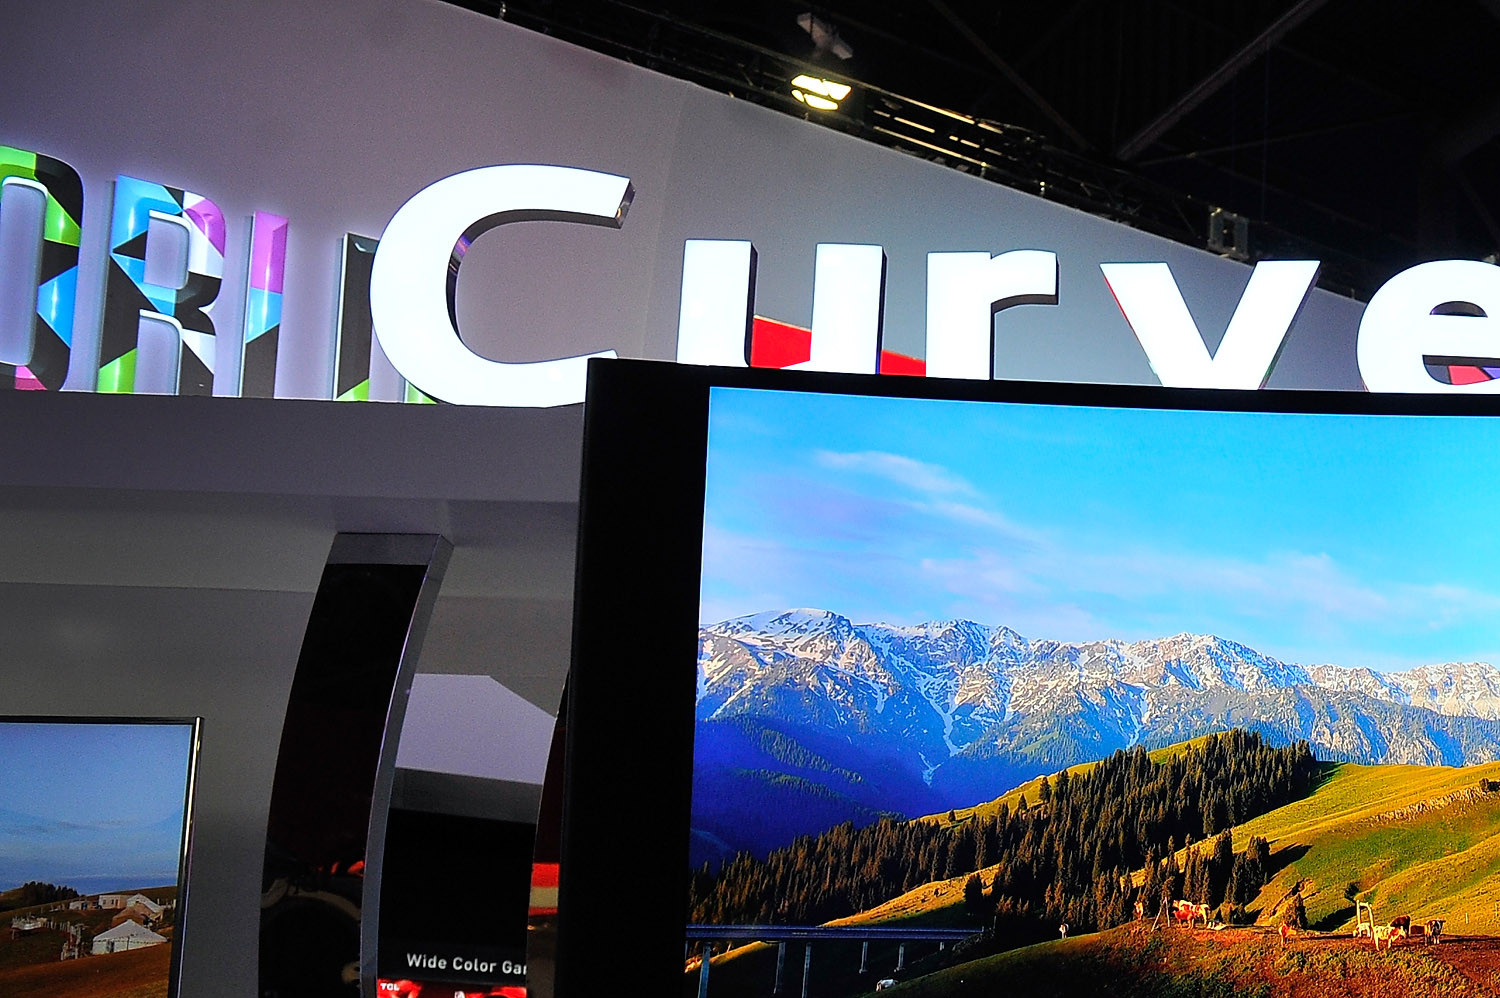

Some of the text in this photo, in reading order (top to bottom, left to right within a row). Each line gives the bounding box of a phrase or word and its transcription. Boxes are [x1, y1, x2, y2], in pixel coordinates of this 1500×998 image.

[406, 952, 447, 970] Wide
[452, 956, 497, 973] Color
[380, 982, 400, 991] TCL
